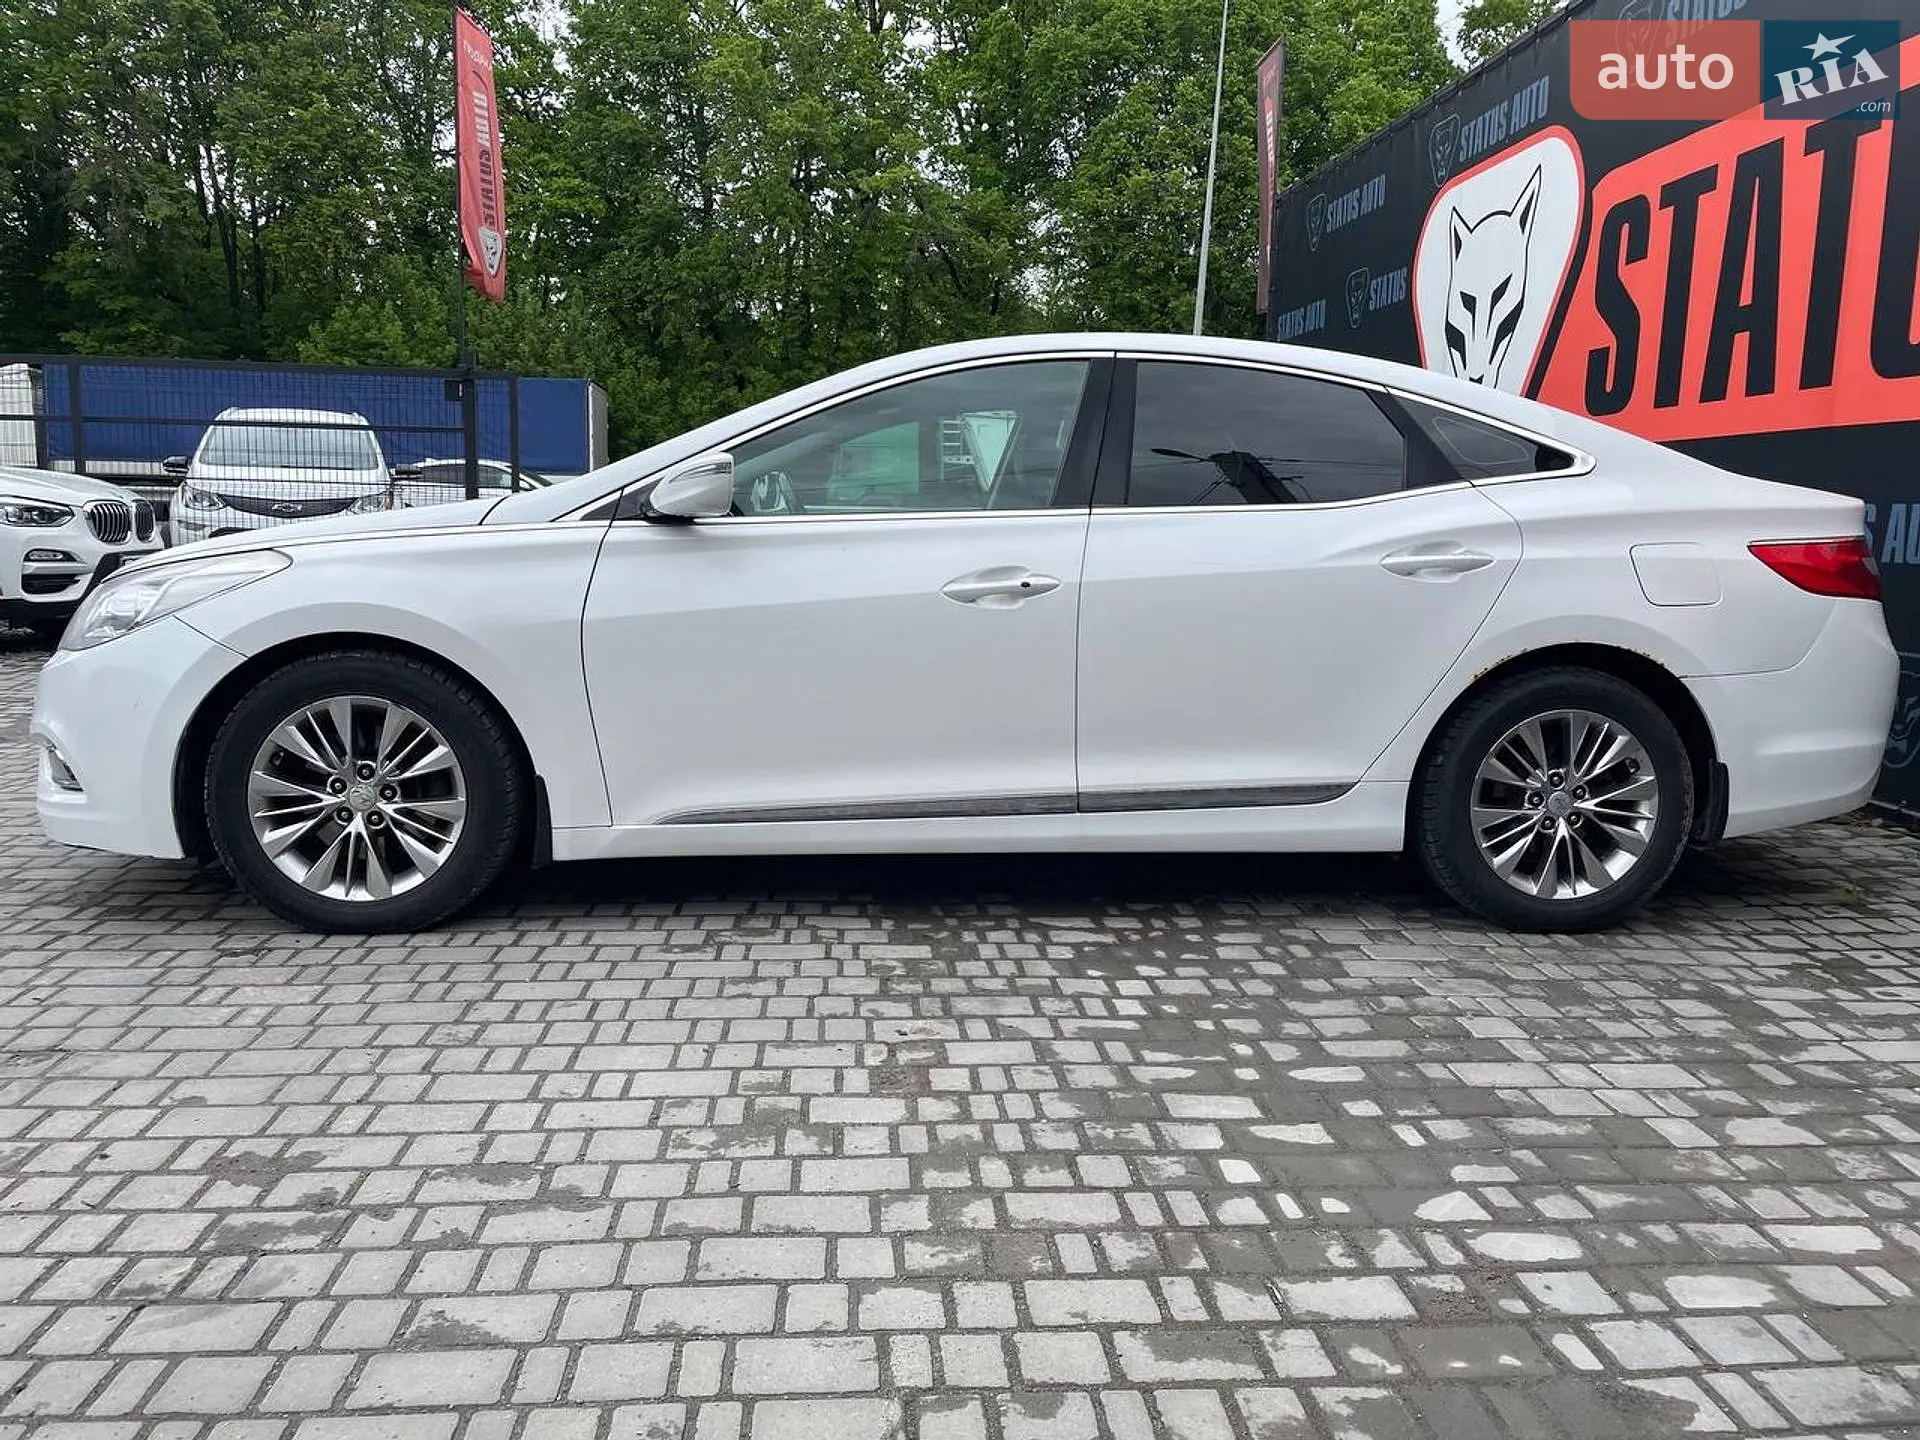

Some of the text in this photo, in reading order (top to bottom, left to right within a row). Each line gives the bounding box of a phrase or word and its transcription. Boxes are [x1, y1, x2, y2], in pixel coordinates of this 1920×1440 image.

[1459, 75, 1549, 163] STATUS AUTO
[1326, 174, 1386, 232] STATUS AUTO
[1369, 265, 1408, 310] STATUS
[1277, 306, 1304, 341] STATUS
